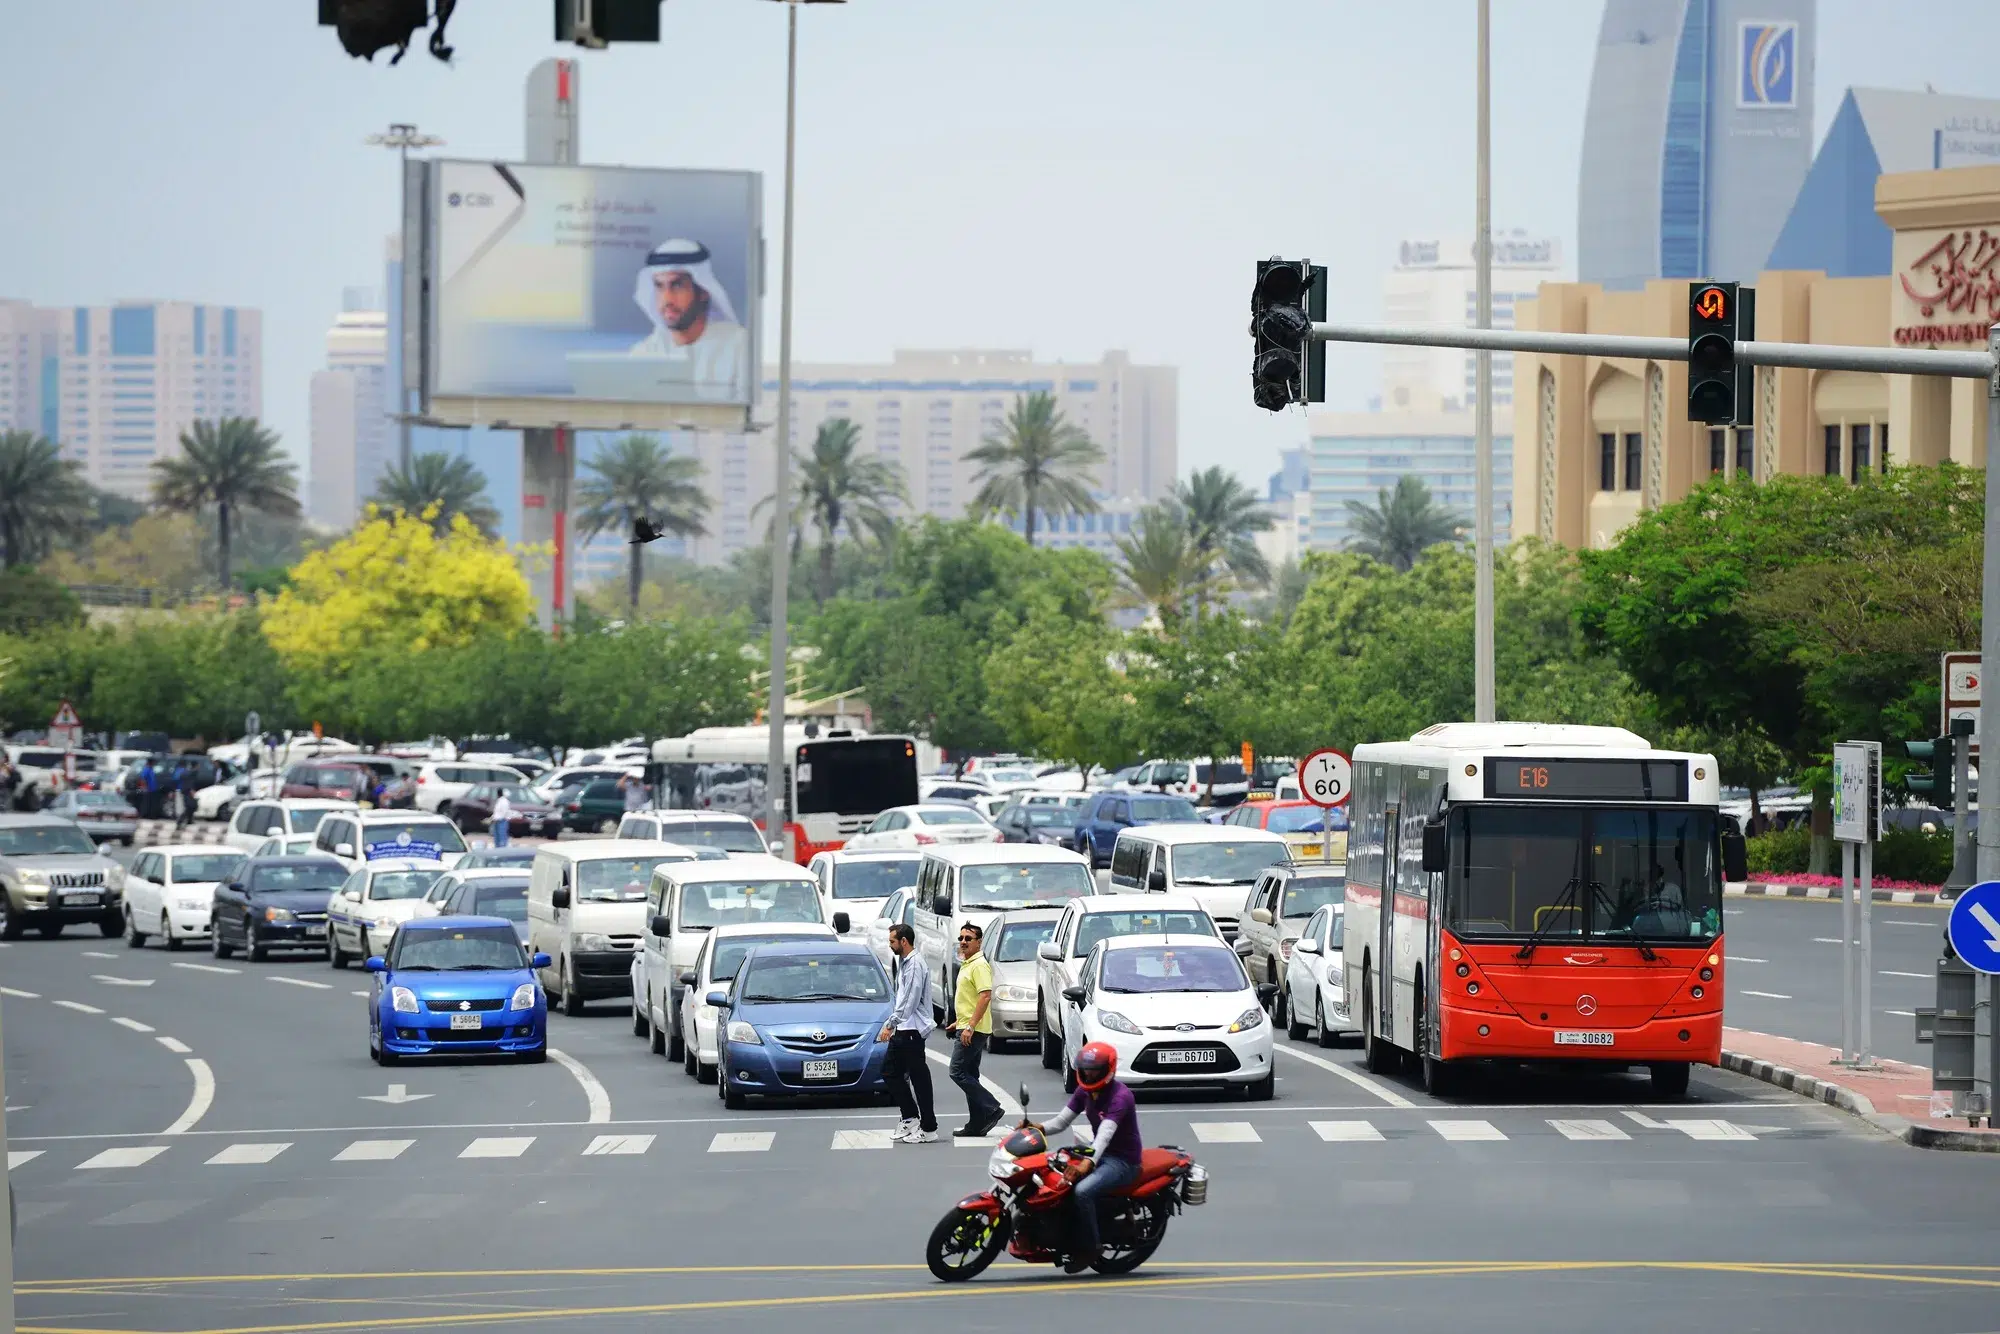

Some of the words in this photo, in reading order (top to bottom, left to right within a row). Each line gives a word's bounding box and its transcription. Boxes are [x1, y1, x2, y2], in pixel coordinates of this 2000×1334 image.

[1519, 767, 1548, 788] E16
[1315, 779, 1341, 796] 60
[1582, 1033, 1612, 1043] 30682
[1161, 1052, 1166, 1062] H
[1184, 1051, 1215, 1062] 66709
[806, 1062, 811, 1071] C
[814, 1062, 836, 1071] 55234
